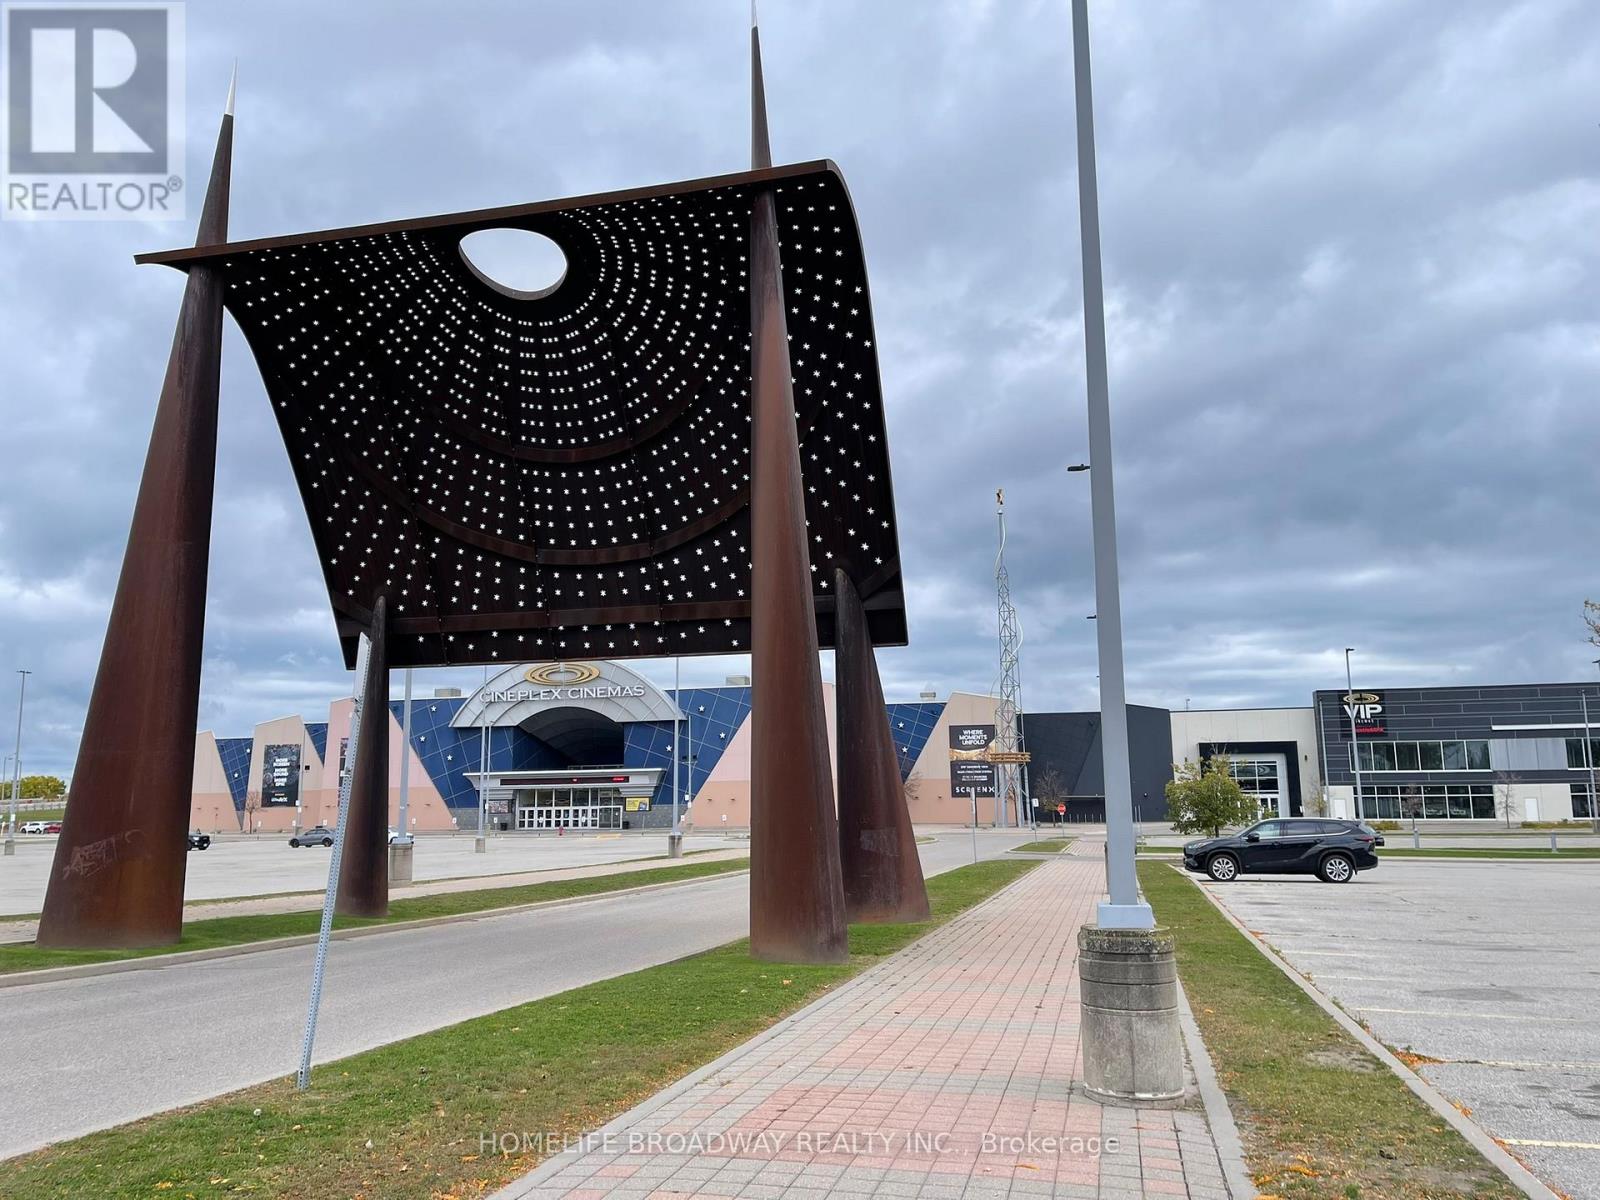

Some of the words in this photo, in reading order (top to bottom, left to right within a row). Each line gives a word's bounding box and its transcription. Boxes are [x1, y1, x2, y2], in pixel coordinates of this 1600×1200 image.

[480, 688, 561, 703] CINEPLEX
[568, 685, 645, 699] CINEMAS
[1343, 704, 1383, 719] VIP
